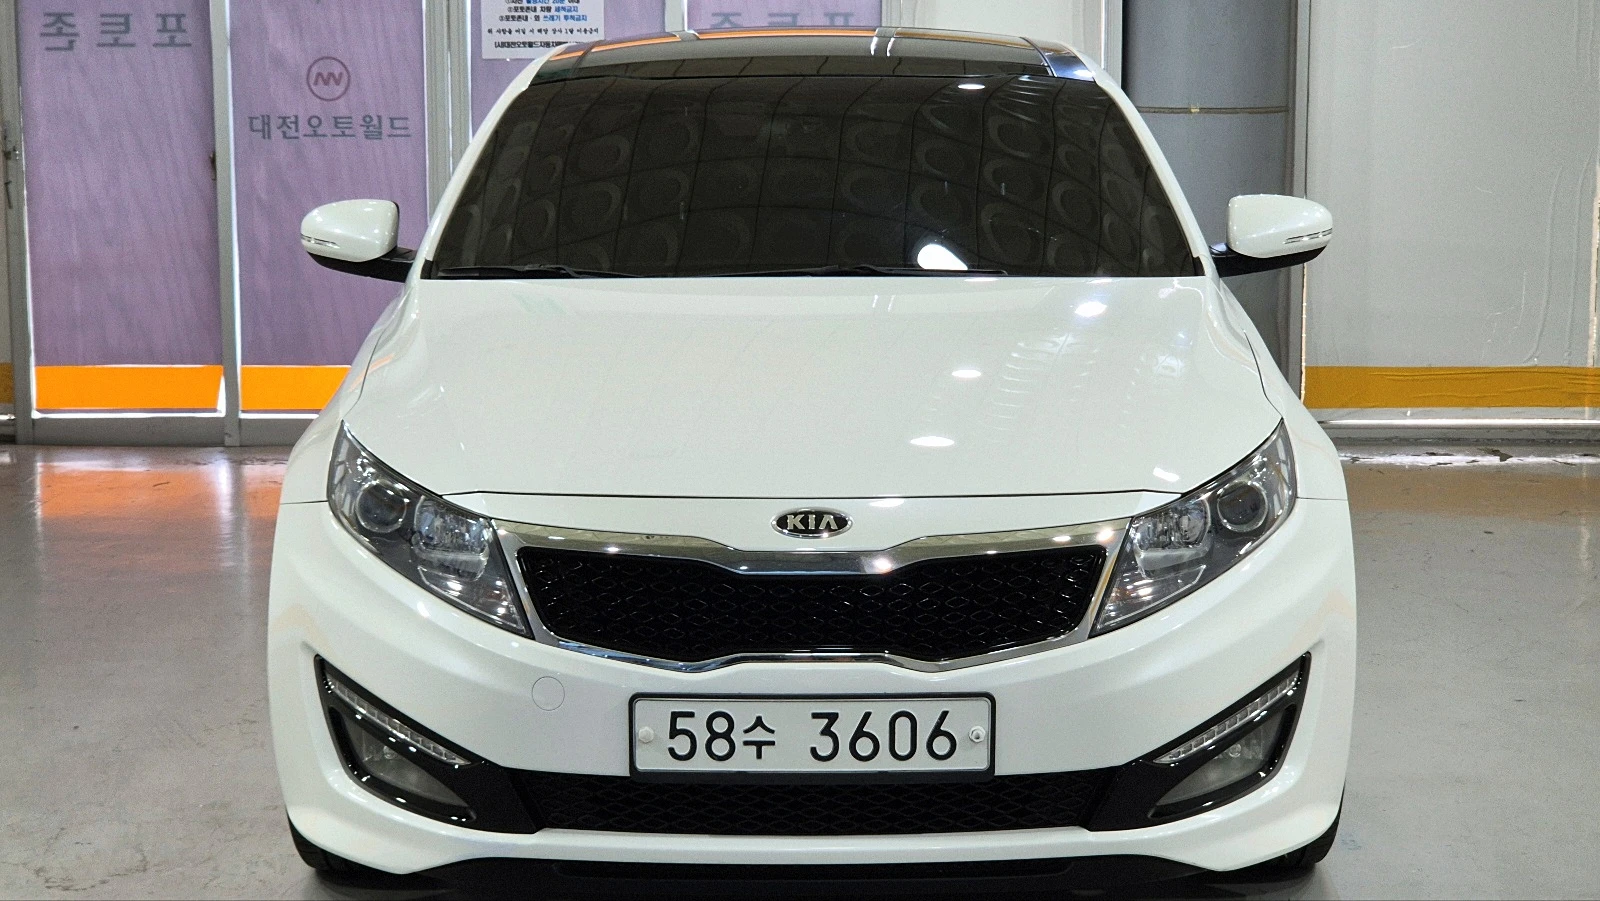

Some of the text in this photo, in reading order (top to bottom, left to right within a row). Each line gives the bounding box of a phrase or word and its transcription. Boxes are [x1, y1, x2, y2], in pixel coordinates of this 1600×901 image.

[248, 114, 412, 140] 대전오토월드
[786, 513, 839, 531] KIA
[667, 710, 958, 762] 58수 3606
